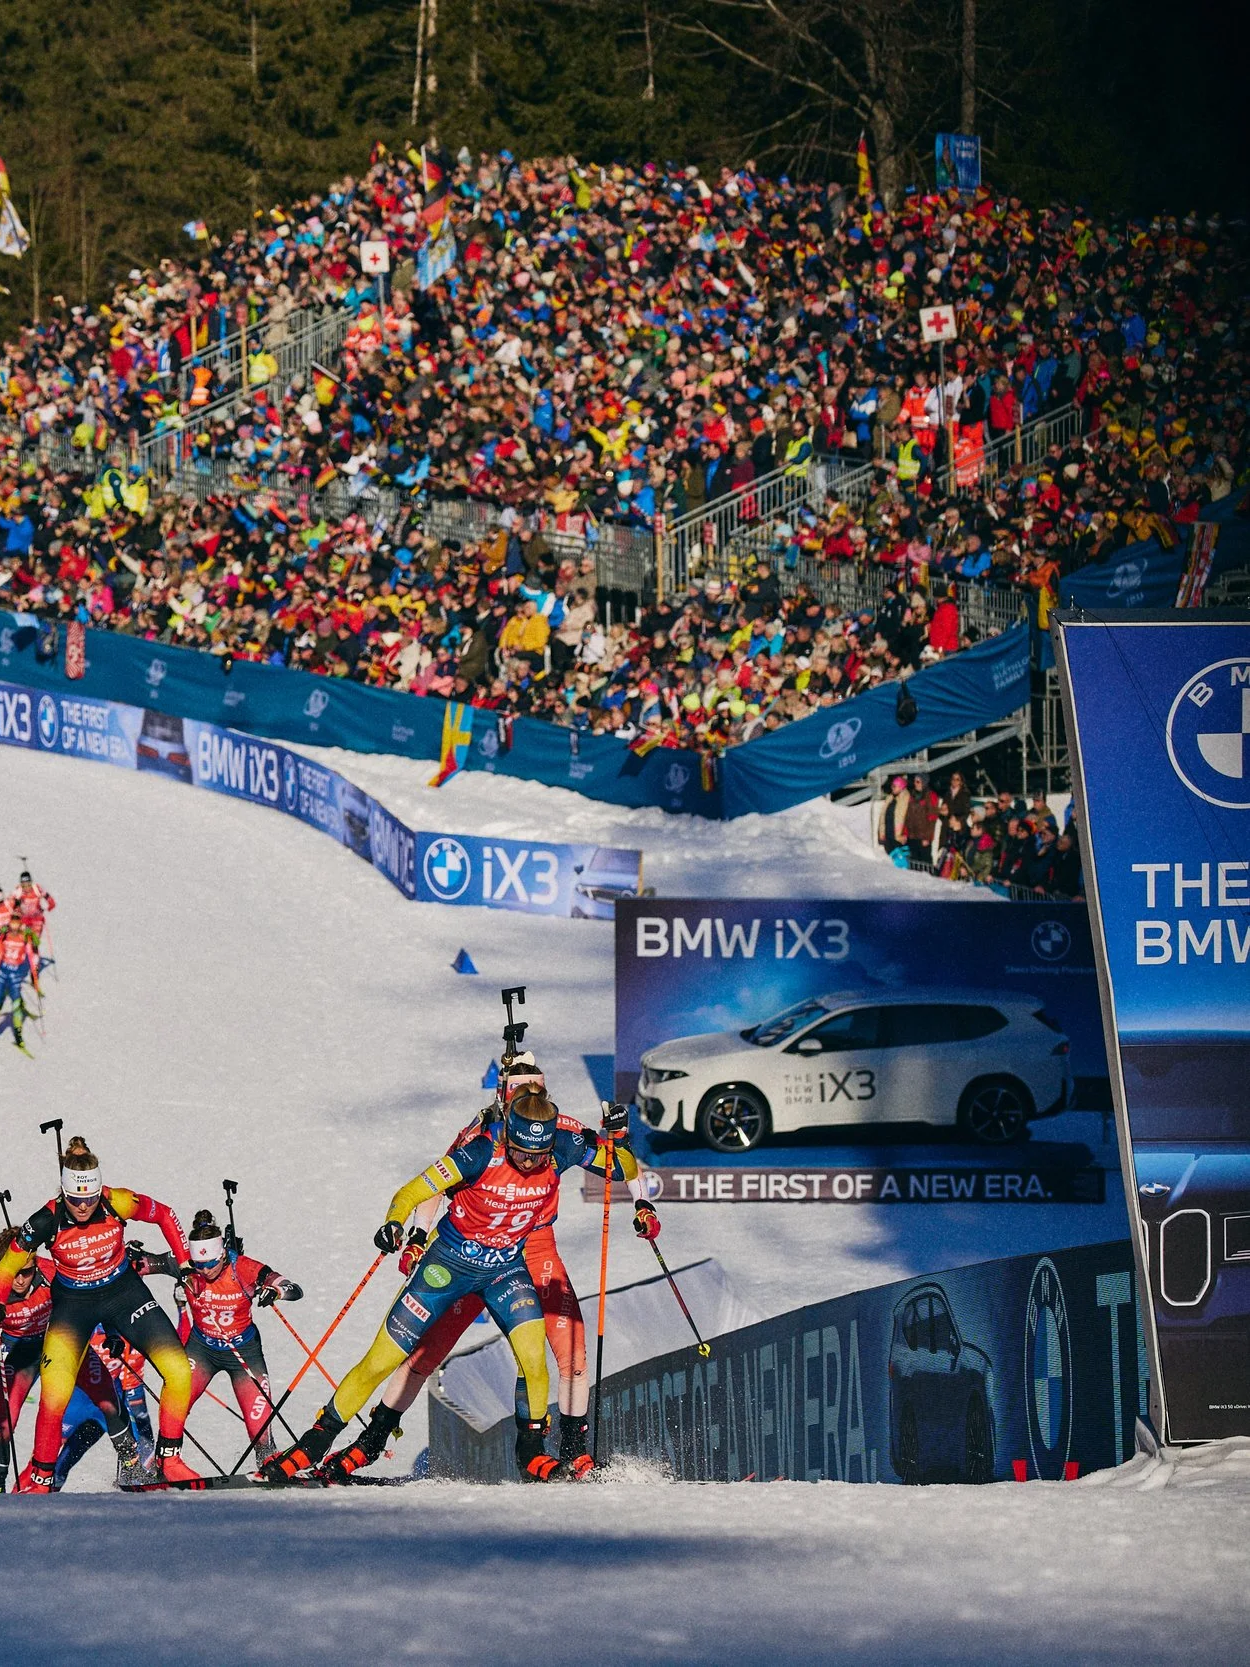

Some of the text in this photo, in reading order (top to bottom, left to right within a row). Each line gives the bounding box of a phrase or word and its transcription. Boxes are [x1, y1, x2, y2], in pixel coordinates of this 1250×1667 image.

[60, 700, 111, 730] THE FIRST
[61, 725, 78, 750] OF
[198, 730, 280, 802] BMW iX3
[482, 846, 559, 905] iX3
[1131, 862, 1250, 909] THE
[636, 916, 851, 961] BMW iX3
[819, 1069, 877, 1103] iX3
[515, 1130, 543, 1142] Monitor
[673, 1173, 1054, 1200] THE FIRST OF A NEW ERA.
[484, 1197, 543, 1211] Heat pumps
[487, 1210, 534, 1233] 19
[59, 1226, 120, 1250] VIESSMANN
[66, 1240, 118, 1261] Heat pumps
[211, 1303, 238, 1311] pumps
[404, 1294, 430, 1321] NIBE
[509, 1299, 535, 1313] ATG
[725, 1356, 741, 1483] A
[743, 1336, 796, 1483] NEW
[803, 1319, 877, 1484] ERA.
